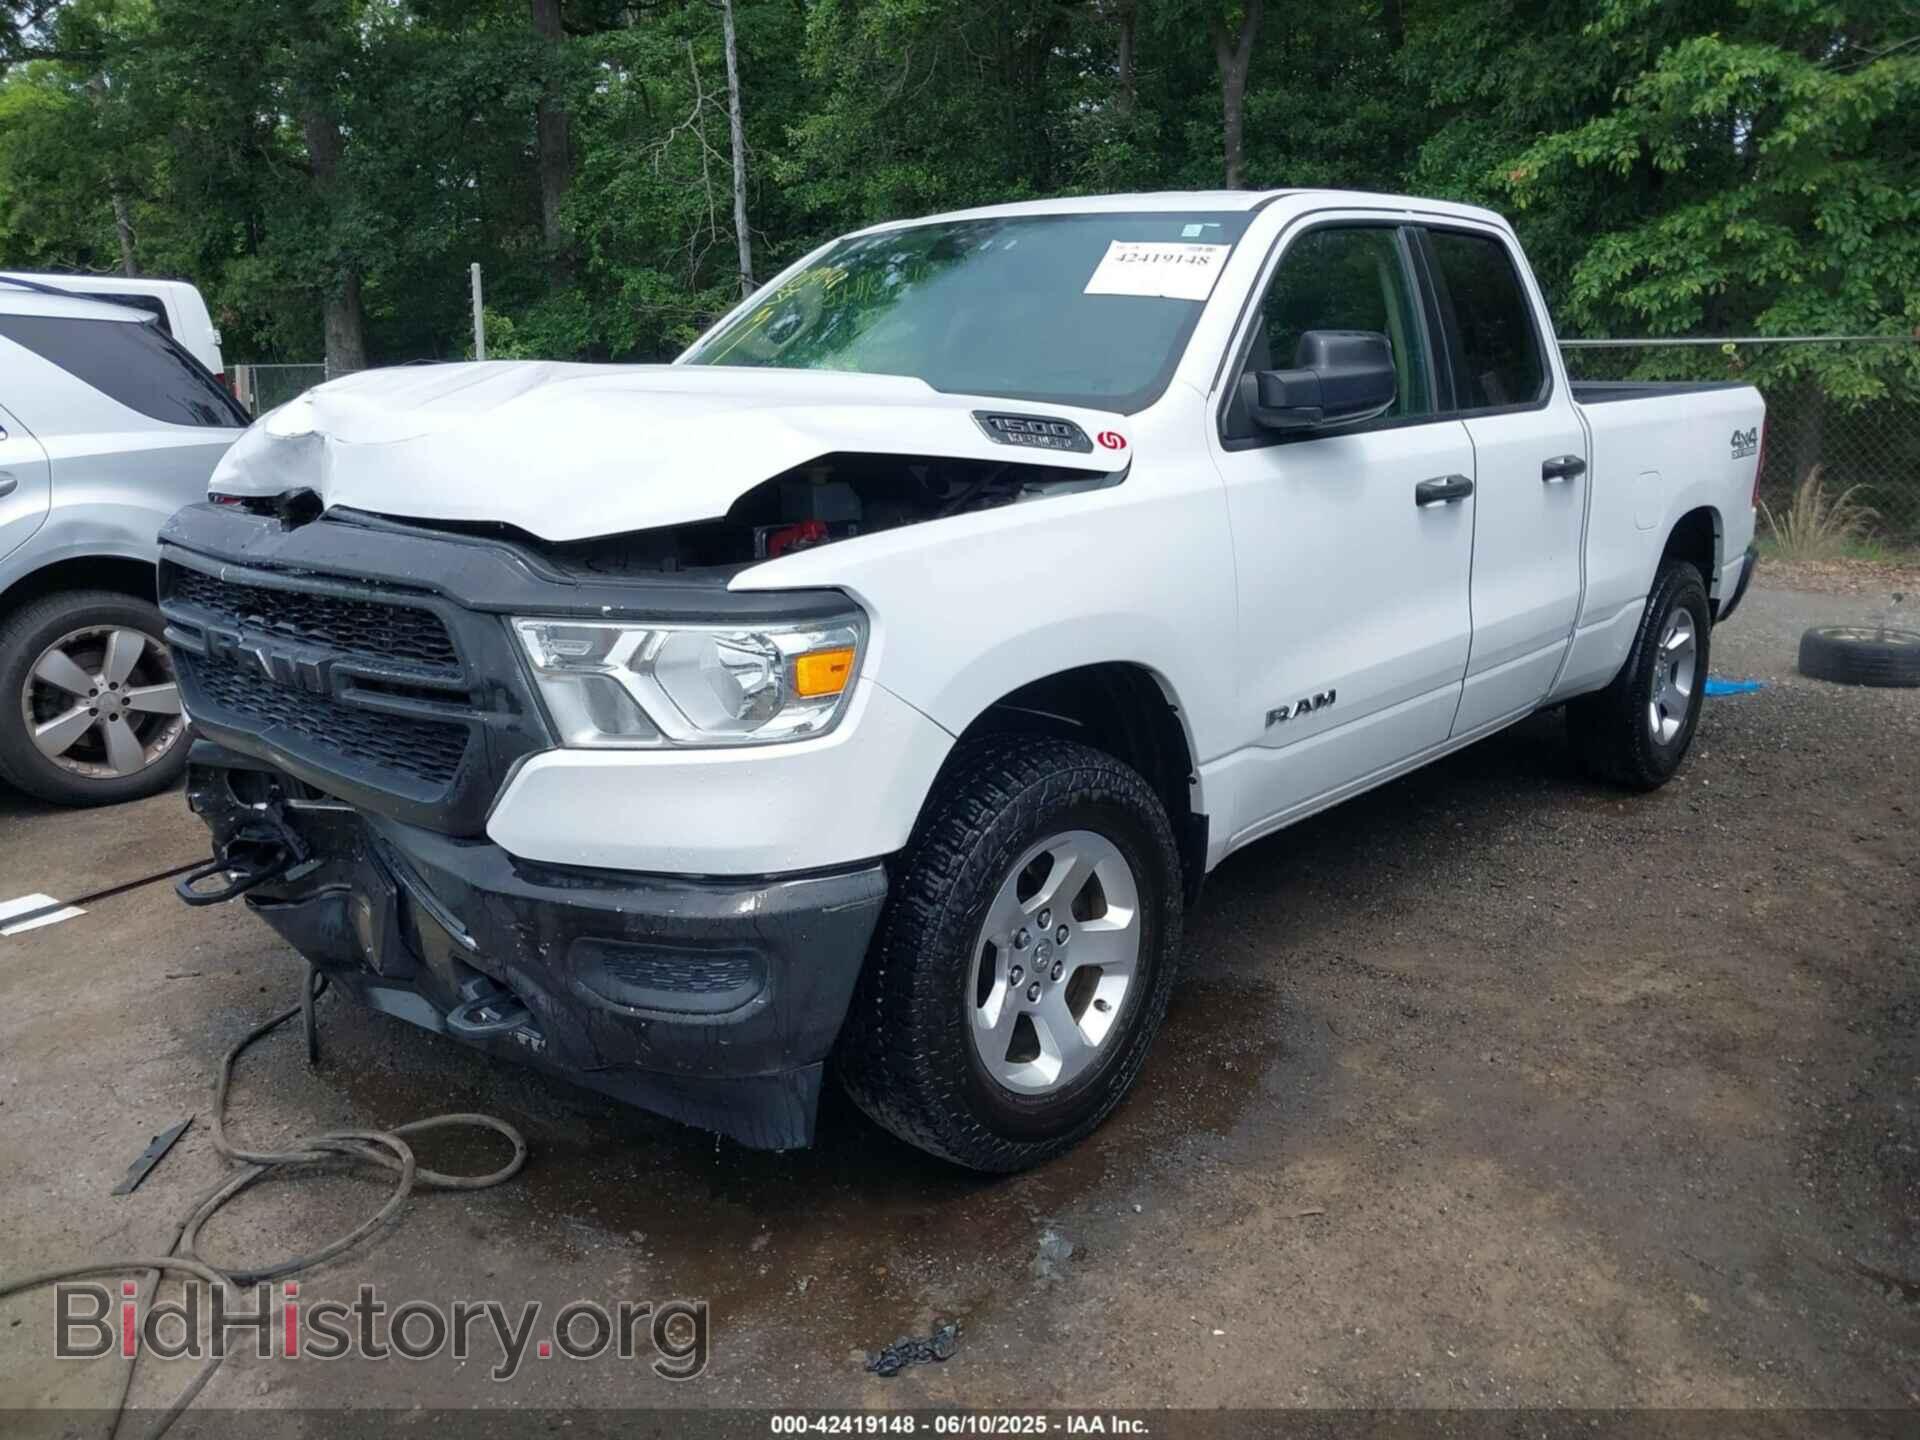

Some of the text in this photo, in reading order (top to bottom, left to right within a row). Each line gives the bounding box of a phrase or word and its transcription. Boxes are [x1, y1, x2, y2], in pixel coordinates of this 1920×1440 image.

[1115, 253, 1210, 266] 42419148
[988, 417, 1070, 438] 1500
[1265, 689, 1336, 728] RAM
